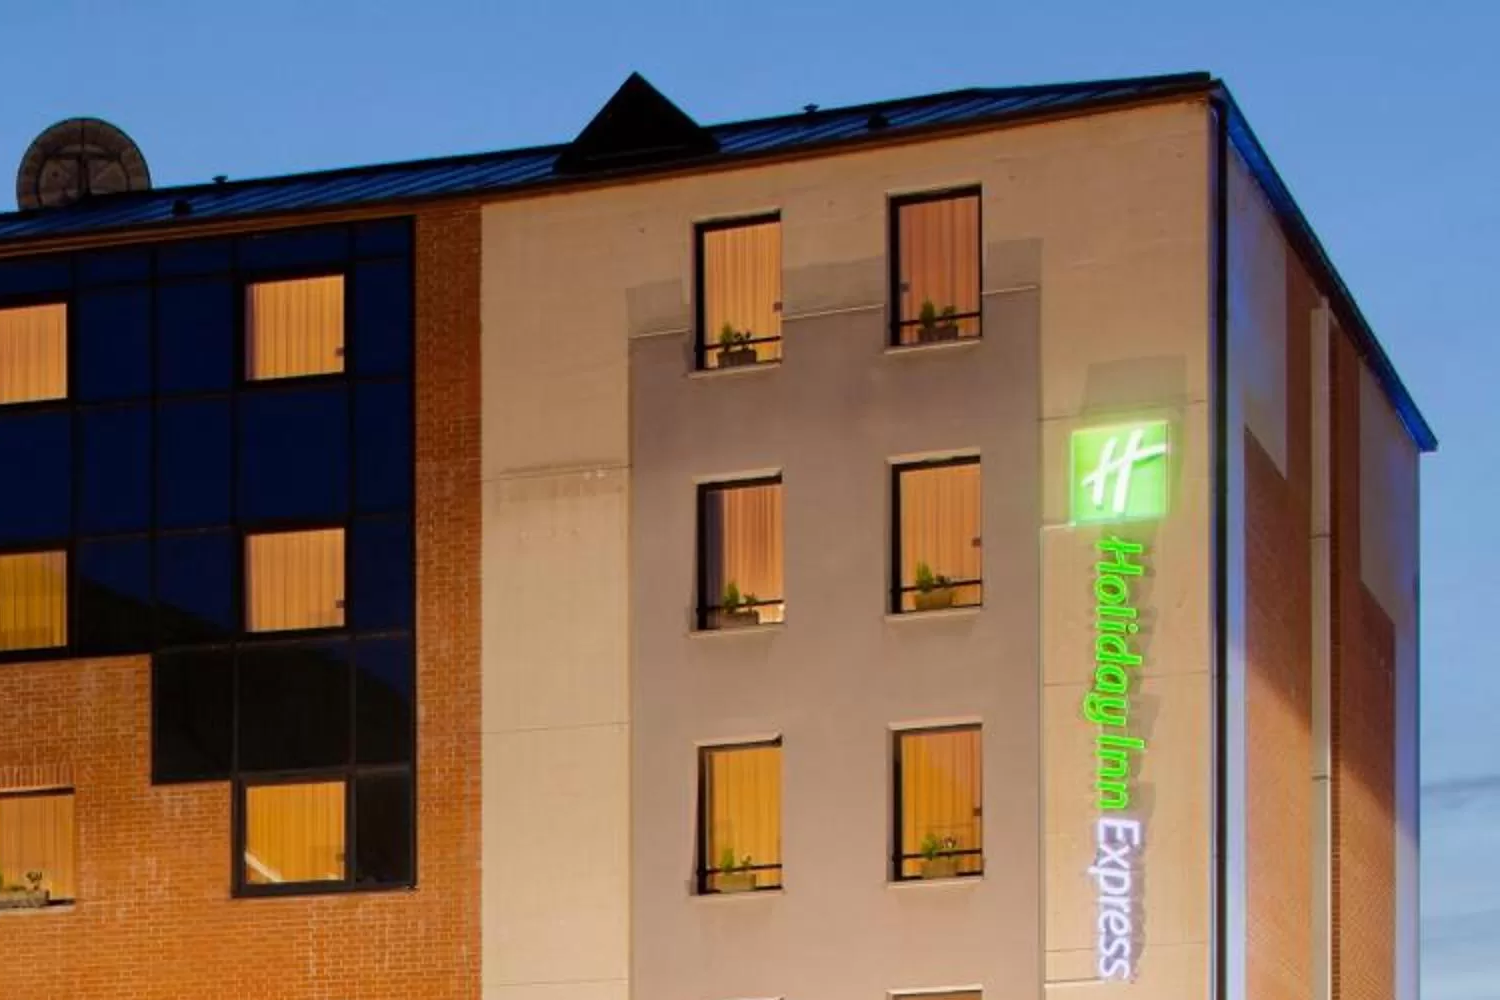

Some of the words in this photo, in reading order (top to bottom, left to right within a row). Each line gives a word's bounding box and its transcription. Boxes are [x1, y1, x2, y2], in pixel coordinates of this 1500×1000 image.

[1085, 536, 1144, 726] Holiday
[1095, 734, 1145, 810] Inn
[1087, 817, 1141, 979] Express
